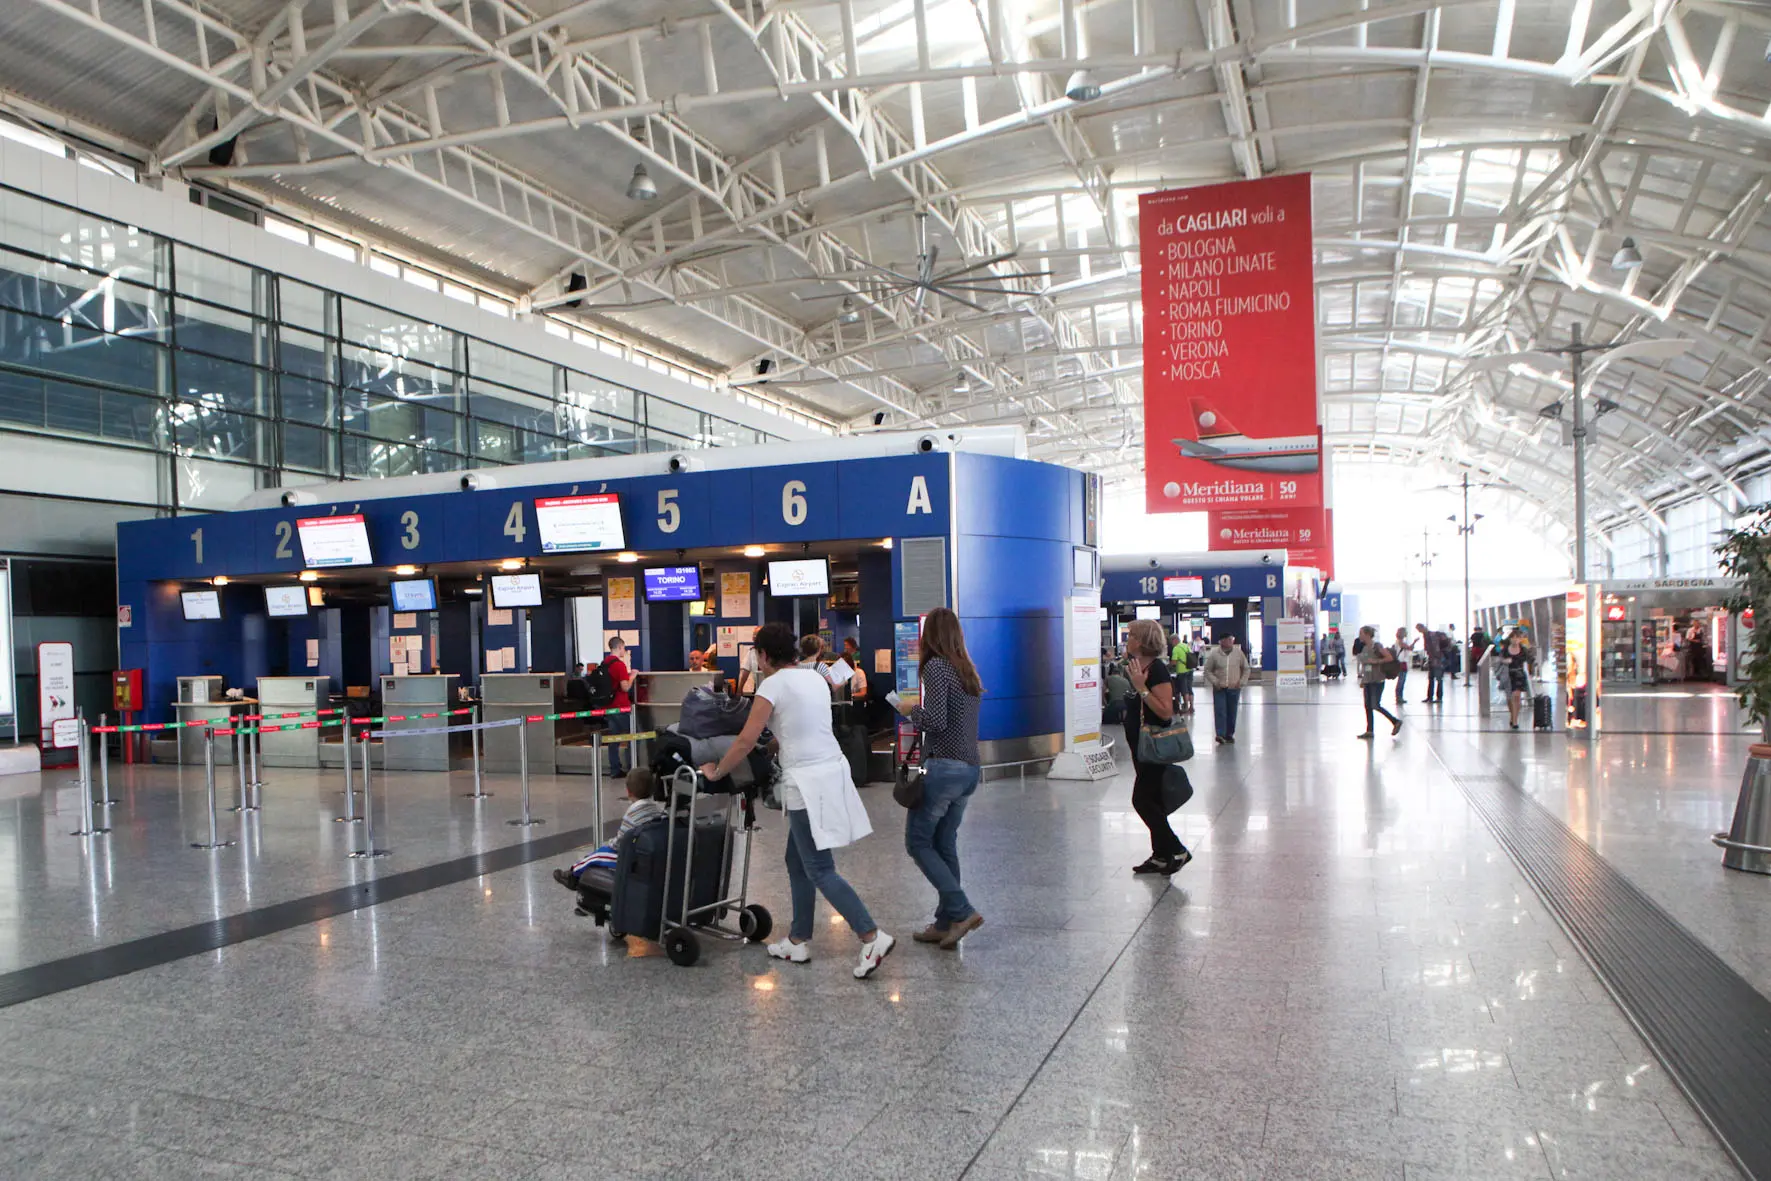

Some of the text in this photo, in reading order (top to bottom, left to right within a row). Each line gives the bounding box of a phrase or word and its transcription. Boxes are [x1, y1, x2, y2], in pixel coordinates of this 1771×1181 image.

[1158, 205, 1285, 236] da CAGLIARI voli a
[1168, 236, 1236, 261] BOLOGNA
[1168, 252, 1276, 280] MILANO LINATE
[1169, 279, 1220, 300] NAPOLI
[1169, 291, 1290, 320] ROMA FIUMICINO
[1170, 319, 1222, 341] TORINO
[1170, 340, 1229, 361] VERONA
[1171, 361, 1221, 381] MOSCA
[906, 476, 933, 514] A
[1183, 480, 1297, 497] Meridiana 50
[657, 489, 681, 533] 5
[782, 480, 808, 526] 6
[401, 511, 420, 550] 3
[503, 502, 526, 543] 4
[1233, 528, 1311, 538] Meridiana 50
[190, 528, 203, 564] 1
[275, 521, 292, 559] 2
[657, 576, 686, 584] TORINO
[1139, 576, 1158, 594] 18
[1211, 574, 1231, 592] 19
[1266, 574, 1277, 589] B
[1654, 579, 1714, 588] SARDEGNA
[1331, 598, 1338, 607] C
[1088, 762, 1113, 774] SECURITY
